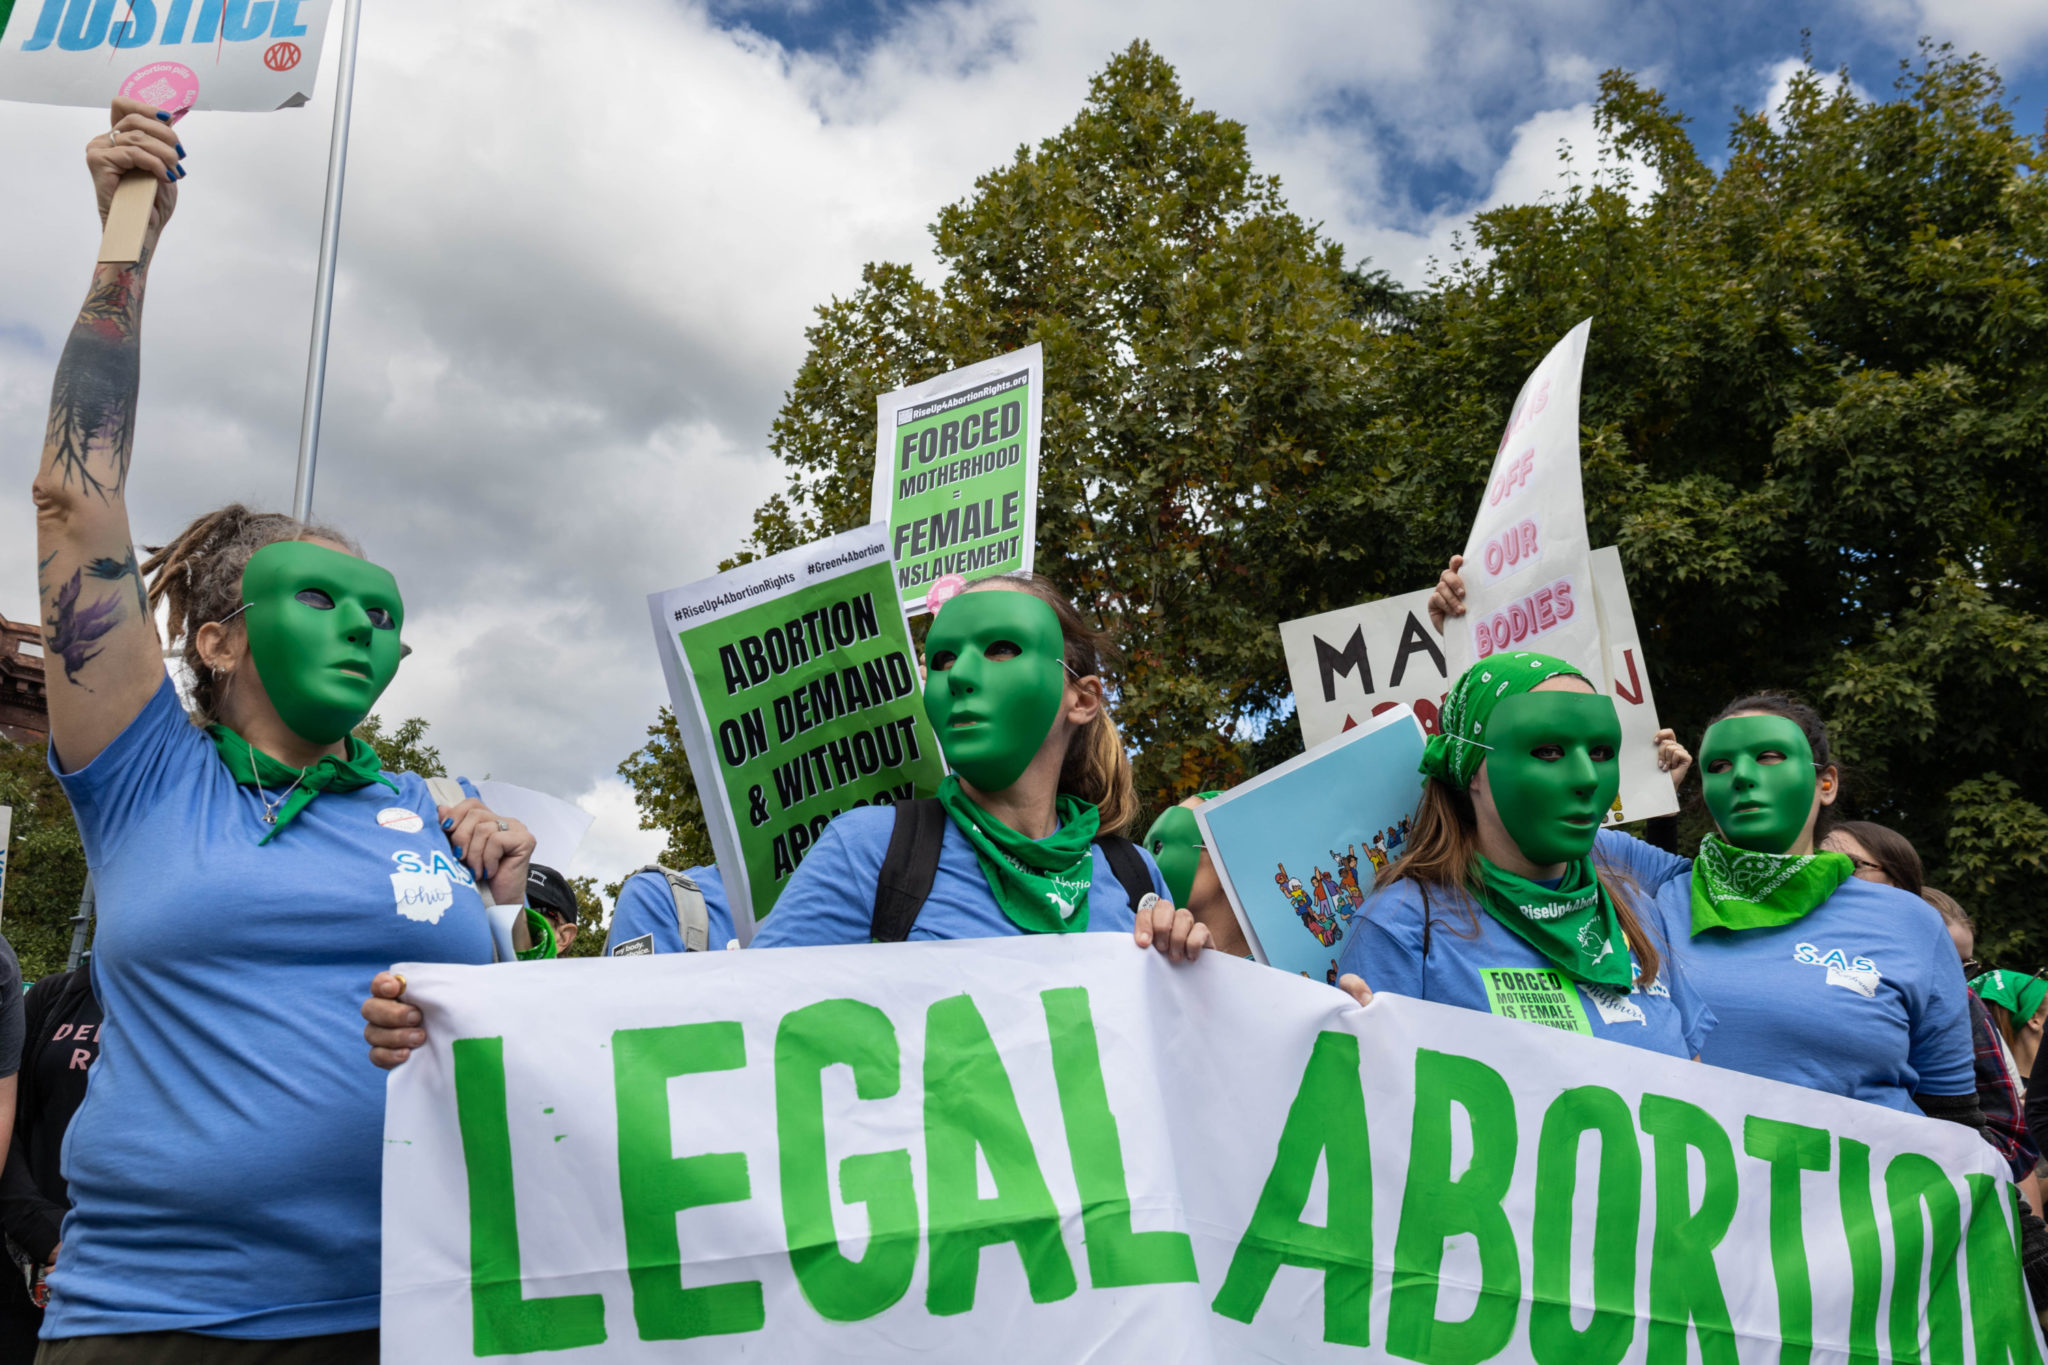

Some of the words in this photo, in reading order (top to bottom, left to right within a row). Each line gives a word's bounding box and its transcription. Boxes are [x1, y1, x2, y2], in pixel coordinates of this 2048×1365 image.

[133, 64, 172, 81] abortion
[913, 374, 1028, 419] RiseUp4AbortionRights.org
[901, 400, 1021, 471] FORCED
[899, 443, 1020, 500] MOTHERHOOD
[1490, 447, 1535, 506] OFF
[893, 490, 1019, 561] FEMALE
[1484, 519, 1539, 576] OUR
[674, 571, 796, 621] #RiseUp4AbortionRights
[807, 542, 885, 575] #Green4Abortion
[897, 535, 1020, 590] NSLAVEMENT
[718, 592, 880, 695] ABORTION
[1475, 581, 1575, 660] BODIES
[719, 708, 769, 767] ON
[773, 651, 914, 743] DEMAND
[748, 784, 770, 827] &
[772, 715, 921, 810] WITHOUT
[1490, 972, 1562, 991] FORCED
[1799, 945, 1878, 975] S.A.S.
[1496, 993, 1567, 1005] MOTHERHOOD
[1501, 1005, 1517, 1019] IS
[1520, 1005, 1575, 1019] FEMALE
[451, 985, 1200, 1357] LEGAL
